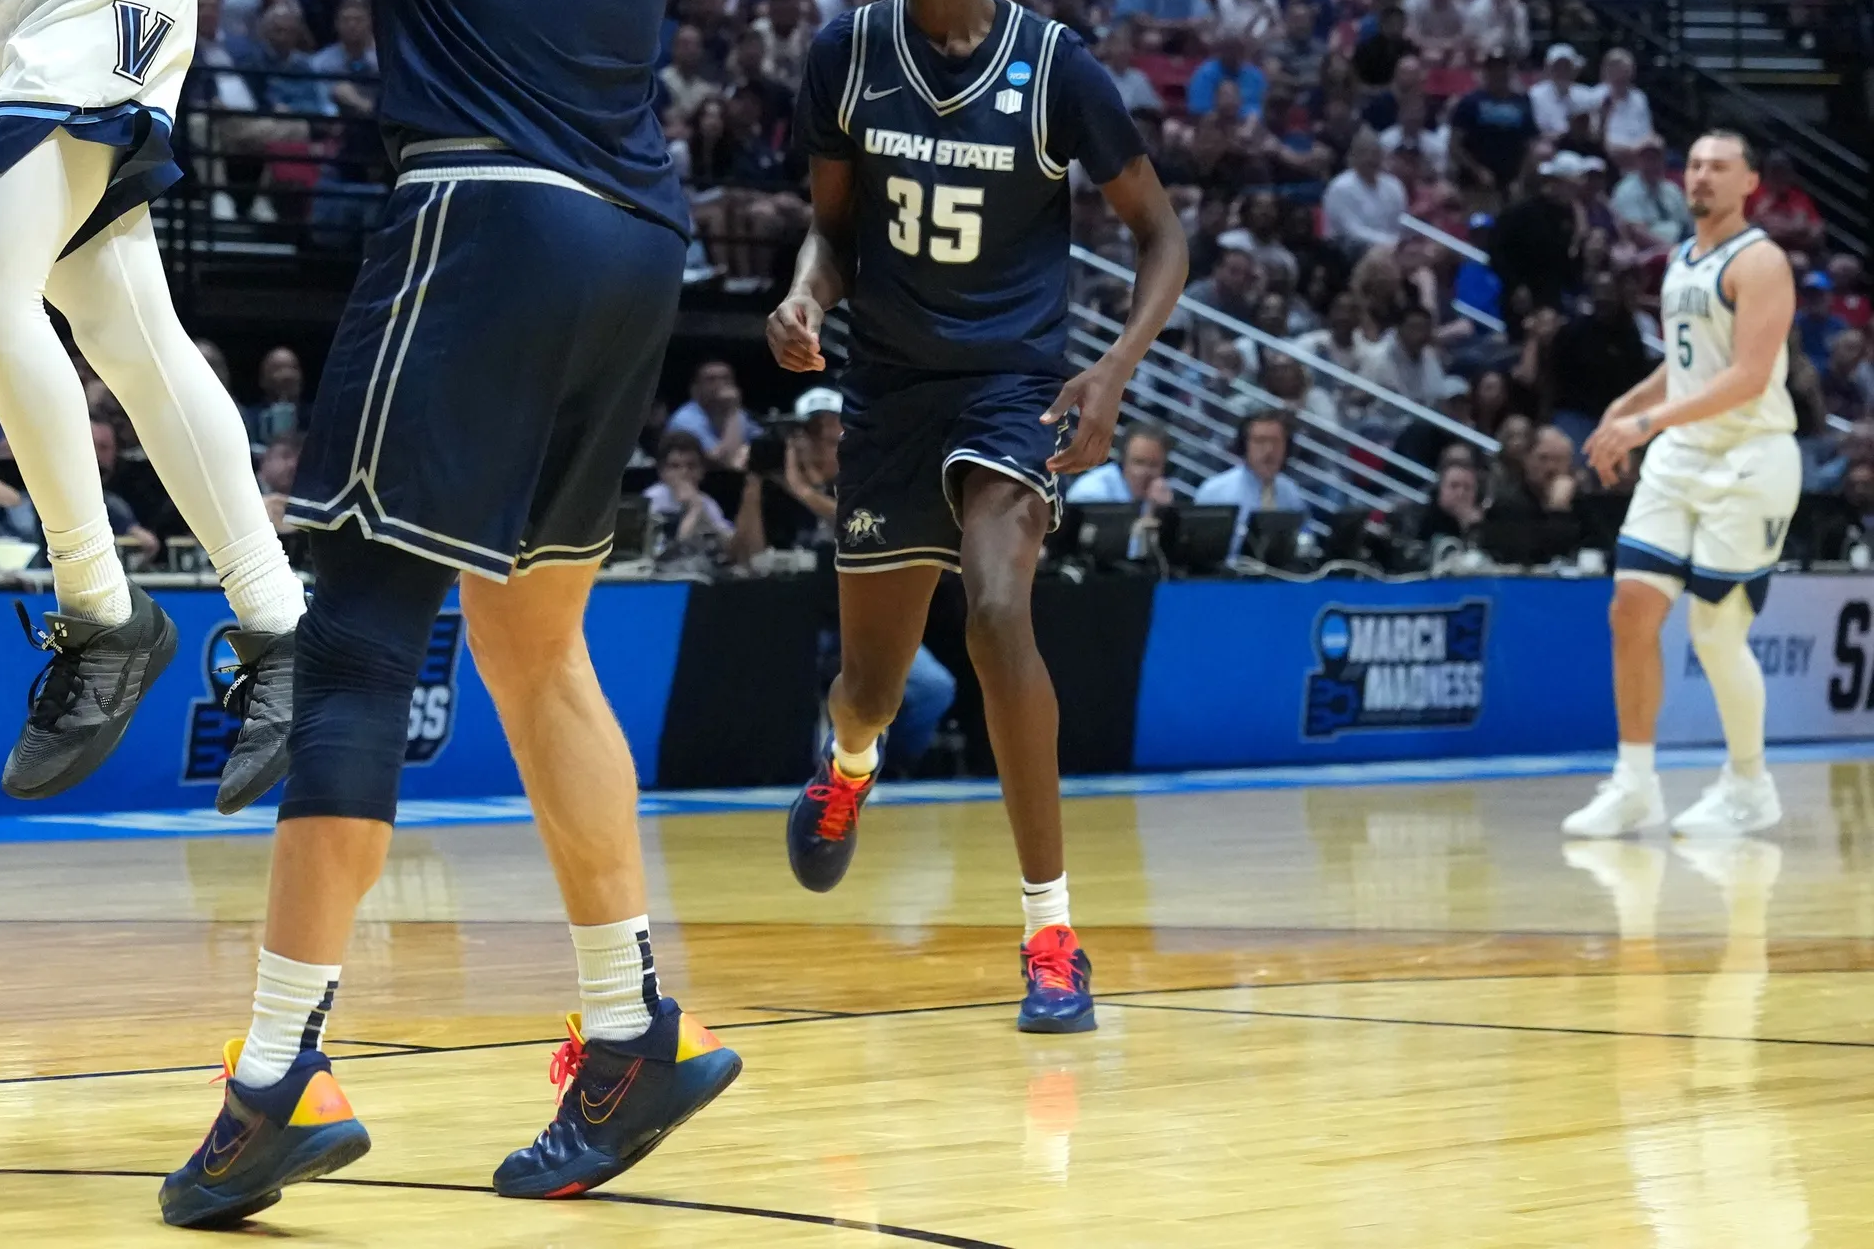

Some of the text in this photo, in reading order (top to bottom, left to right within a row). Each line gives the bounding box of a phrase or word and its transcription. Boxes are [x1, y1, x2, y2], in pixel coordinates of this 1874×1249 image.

[864, 127, 1016, 172] UTAH STATE
[886, 175, 985, 264] 35
[1677, 322, 1693, 369] 5
[1348, 613, 1447, 663] MARCH
[1786, 634, 1816, 678] BY
[1363, 661, 1483, 711] MADNESS
